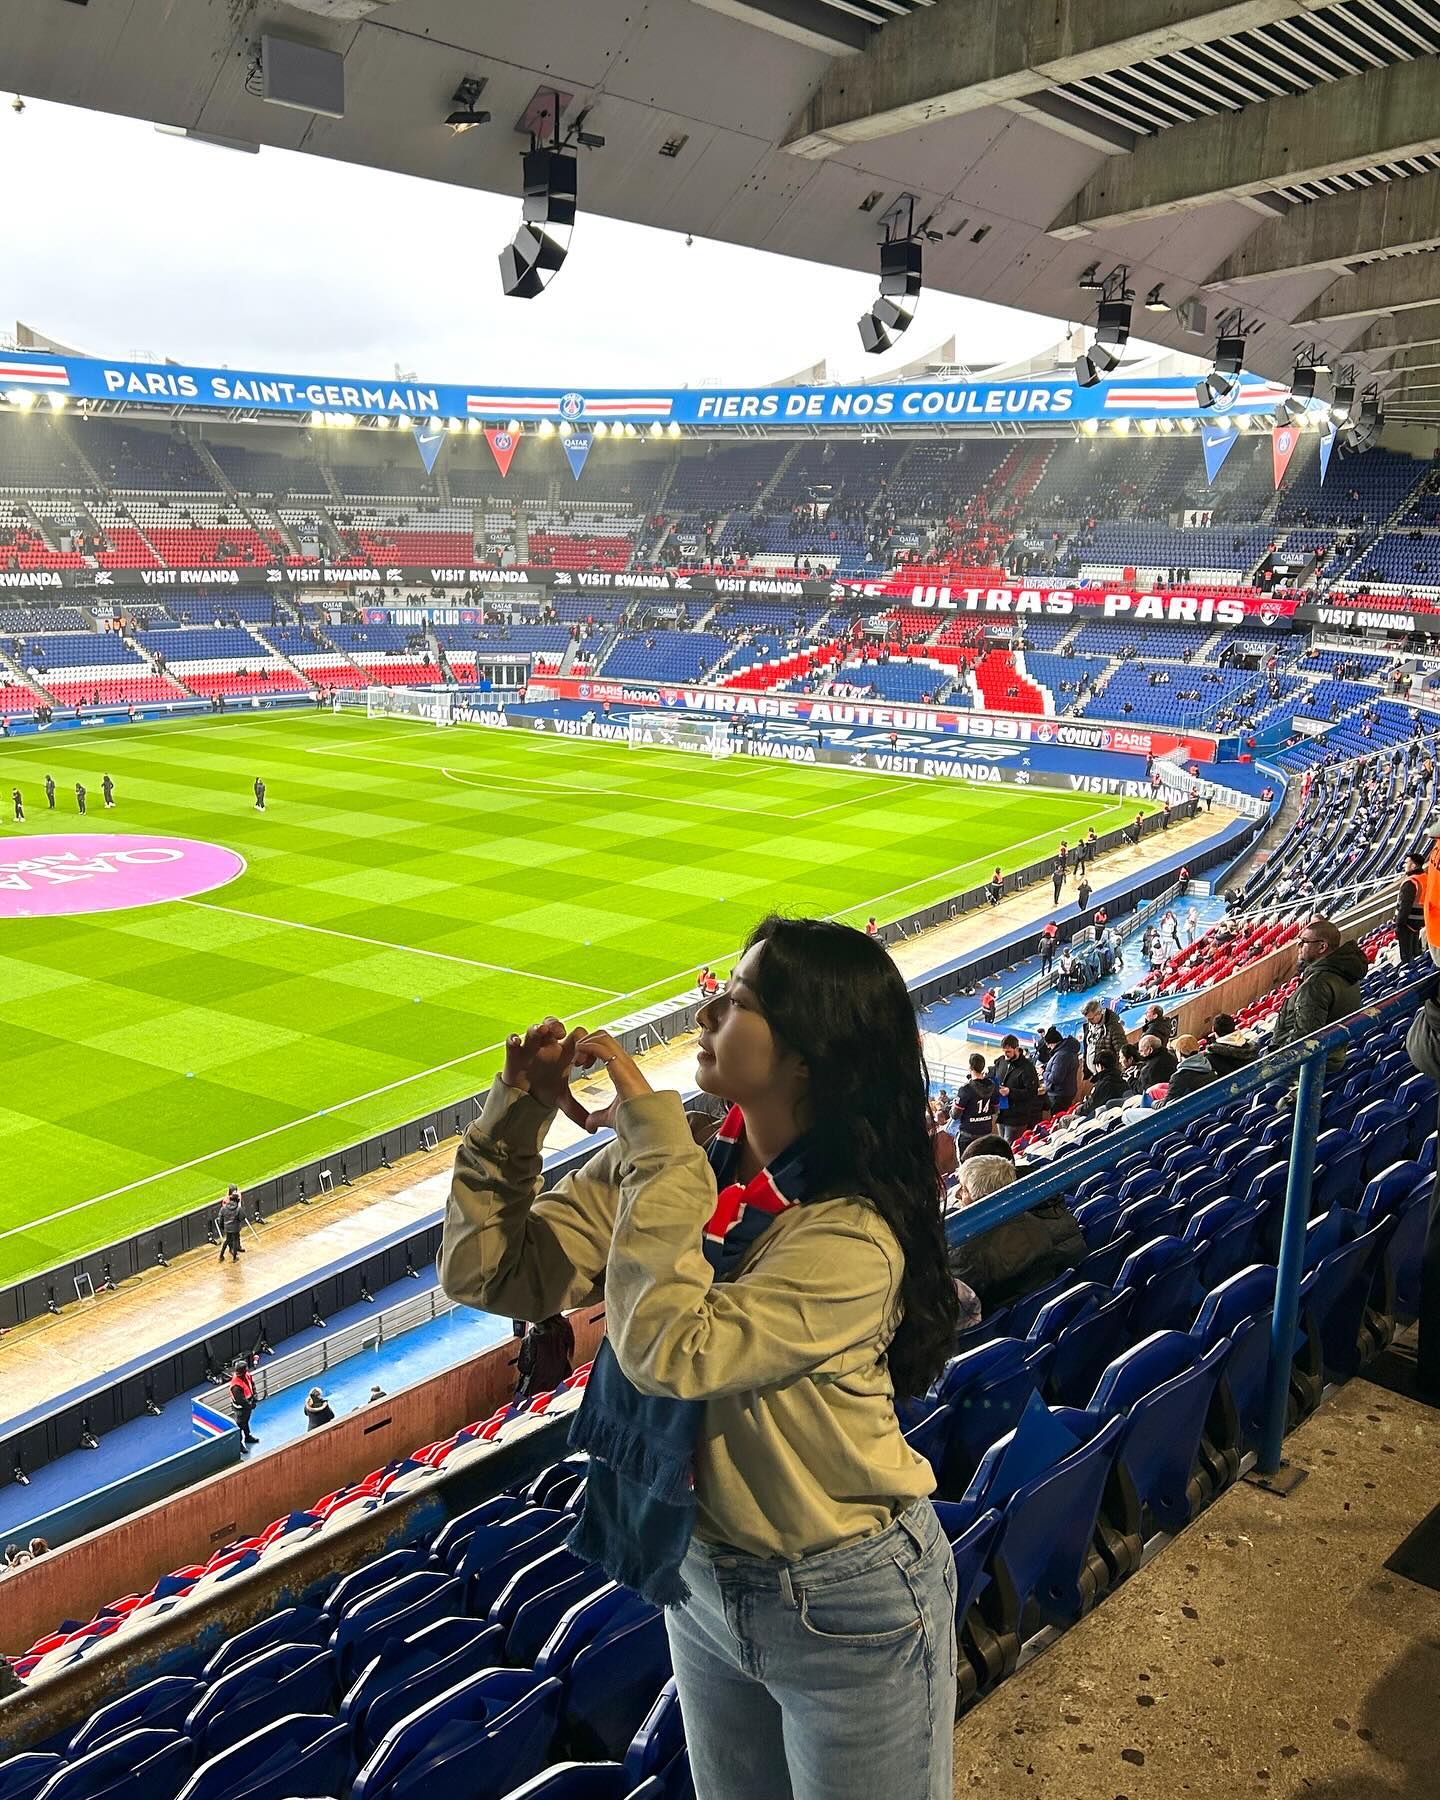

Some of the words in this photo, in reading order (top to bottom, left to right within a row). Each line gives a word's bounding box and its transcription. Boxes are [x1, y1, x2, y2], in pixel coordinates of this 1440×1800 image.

[103, 369, 198, 397] PARIS
[210, 377, 439, 411] SAINT-GERMAIN
[697, 394, 779, 418] FIERS
[785, 393, 826, 416] DE
[830, 392, 895, 416] NOS
[902, 388, 1073, 415] COULEURS
[564, 439, 588, 447] QATAR
[1023, 540, 1044, 548] QATAR
[1280, 553, 1304, 562] QATAR
[141, 570, 176, 584] VISIT
[180, 570, 240, 583] RWANDA
[286, 568, 320, 582] VISIT
[323, 568, 381, 582] RWANDA
[431, 568, 466, 582] VISIT
[469, 568, 529, 583] RWANDA
[577, 573, 612, 587] VISIT
[614, 573, 670, 588] RWANDA
[715, 578, 747, 592] VISIT
[749, 580, 803, 594] RWANDA
[91, 607, 114, 615] QATAR
[911, 585, 1075, 615] ULTRAS
[1103, 594, 1245, 624] PARIS
[1317, 608, 1354, 625] VISIT
[1357, 611, 1415, 631] RWANDA
[1243, 643, 1268, 651] QATAR
[593, 685, 623, 696] PARIS
[452, 707, 508, 726] RWANDA
[683, 691, 800, 718] VIRAGE
[809, 704, 944, 732] AUTEUIL
[957, 717, 1032, 741] 1991
[553, 719, 589, 736] VISIT
[1114, 732, 1151, 747] PARIS
[875, 754, 919, 773] VISIT
[923, 759, 1001, 782] RWANDA
[1069, 774, 1120, 794] VISIT
